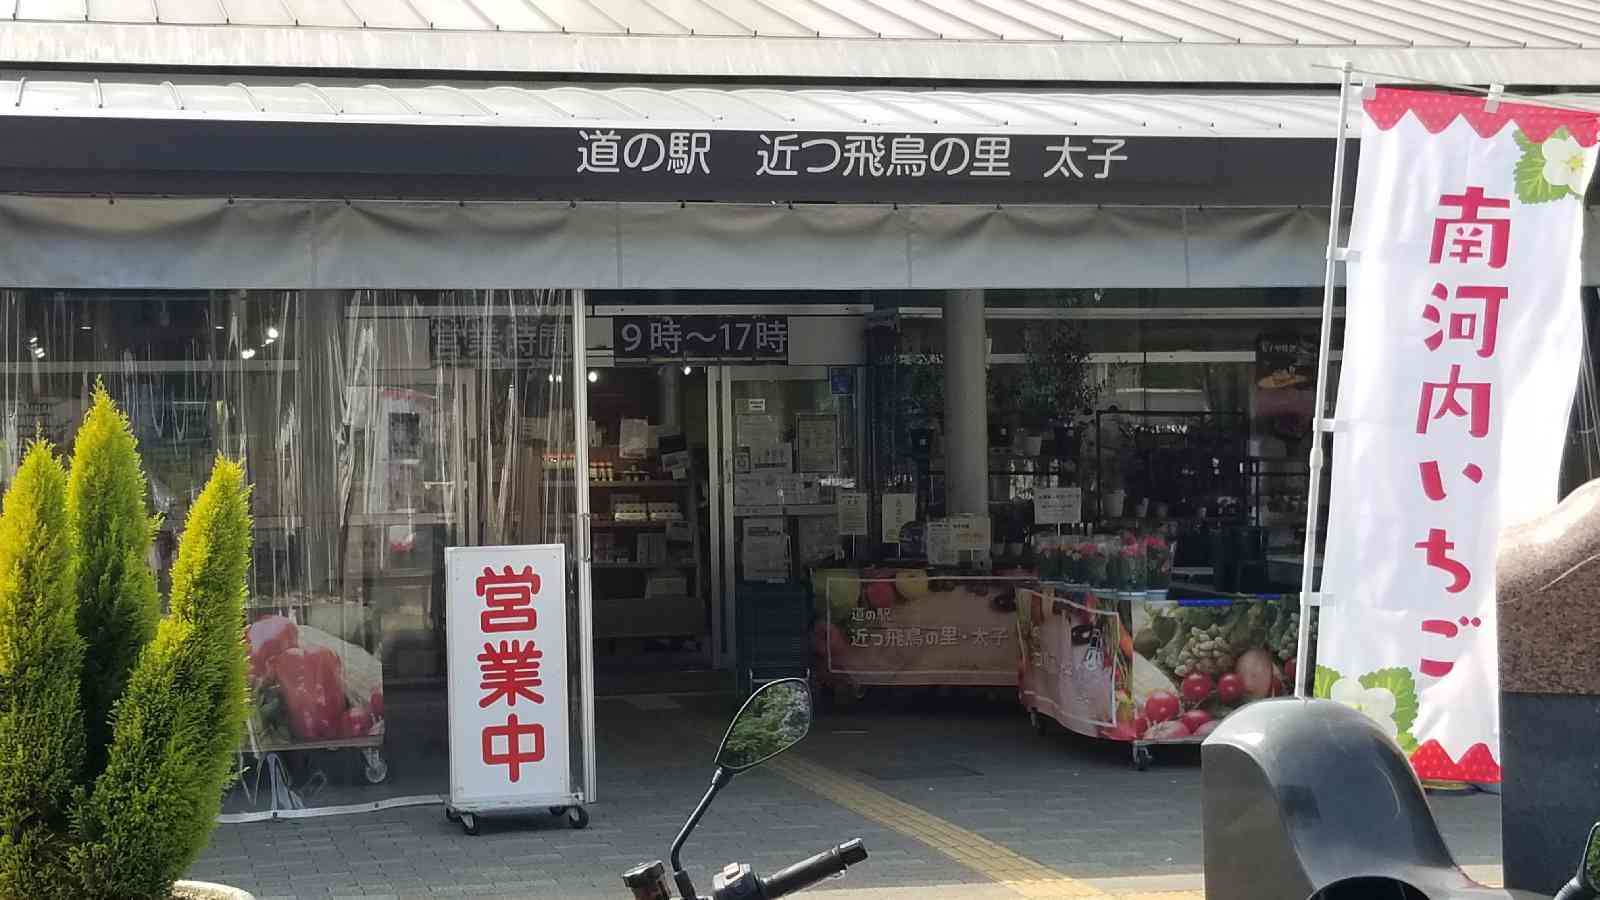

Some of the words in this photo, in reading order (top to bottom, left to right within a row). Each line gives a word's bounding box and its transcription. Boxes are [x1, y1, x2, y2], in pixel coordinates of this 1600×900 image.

[576, 130, 711, 175] 道の駅
[756, 133, 1012, 178] 近つ飛鳥の里
[1043, 137, 1128, 179] 太子
[1413, 186, 1511, 678] 南河内いちご
[476, 566, 544, 782] 営業中
[850, 608, 891, 624] 道の駅
